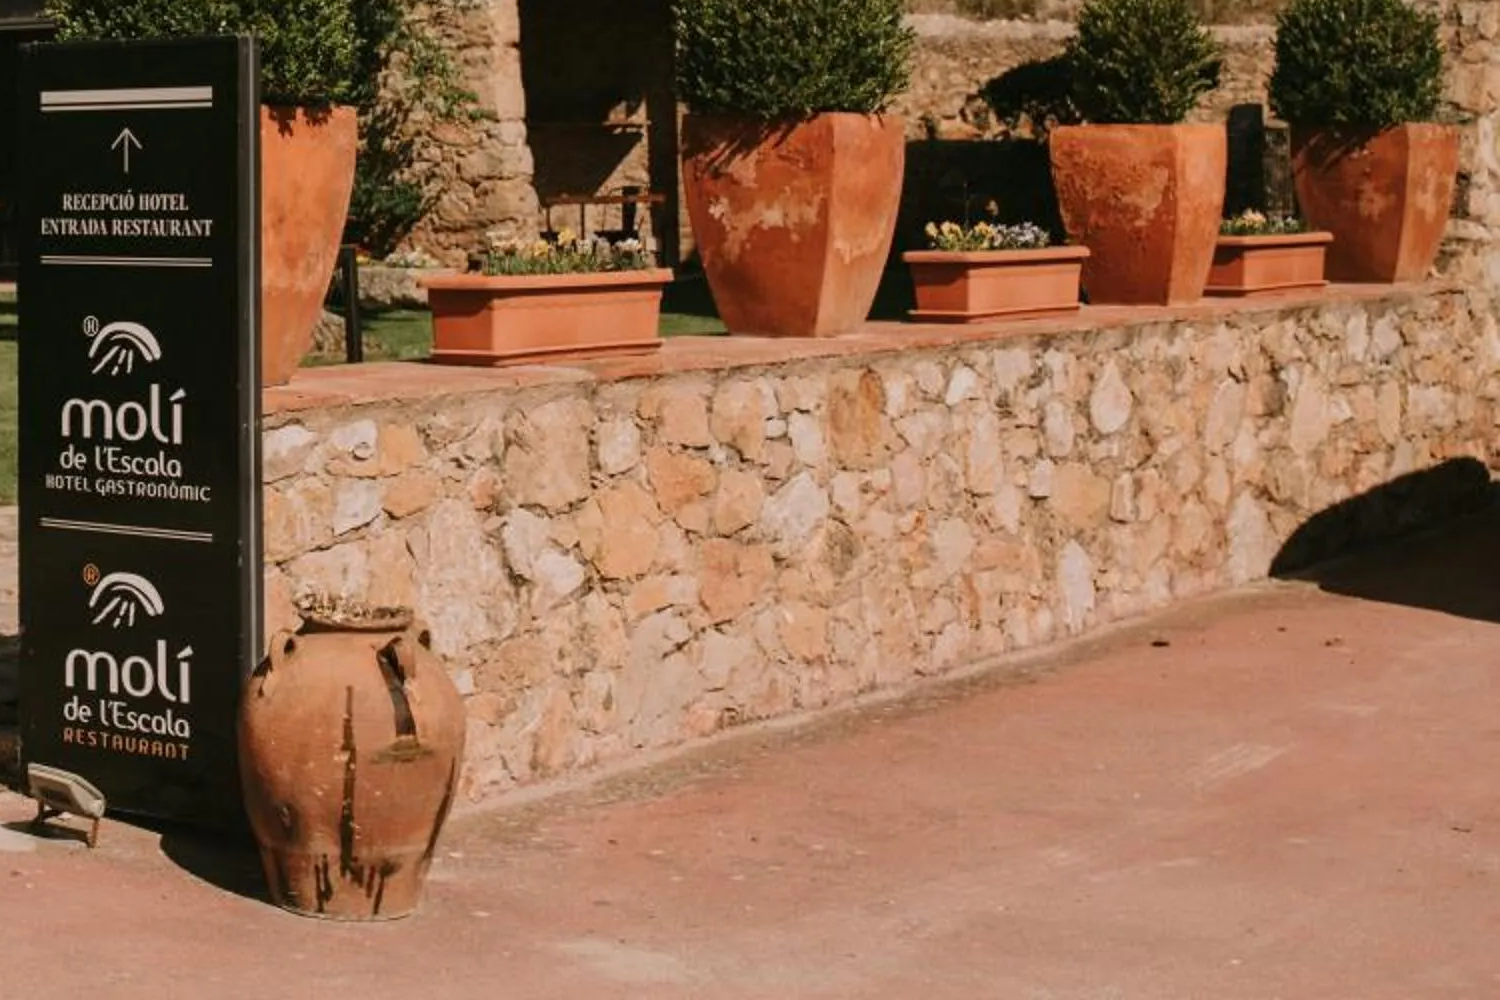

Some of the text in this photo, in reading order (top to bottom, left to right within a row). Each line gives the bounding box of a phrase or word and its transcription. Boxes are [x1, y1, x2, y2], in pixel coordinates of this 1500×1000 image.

[63, 188, 189, 211] RECEPCIÓ HOTEL
[41, 217, 213, 237] ENTRADA RESTAURANT
[61, 383, 187, 445] molí
[60, 444, 182, 478] de l'Escala
[45, 473, 92, 492] HOTEL
[65, 639, 194, 704] molí
[63, 695, 190, 738] de l'Escala
[63, 727, 190, 761] RESTAURANT
